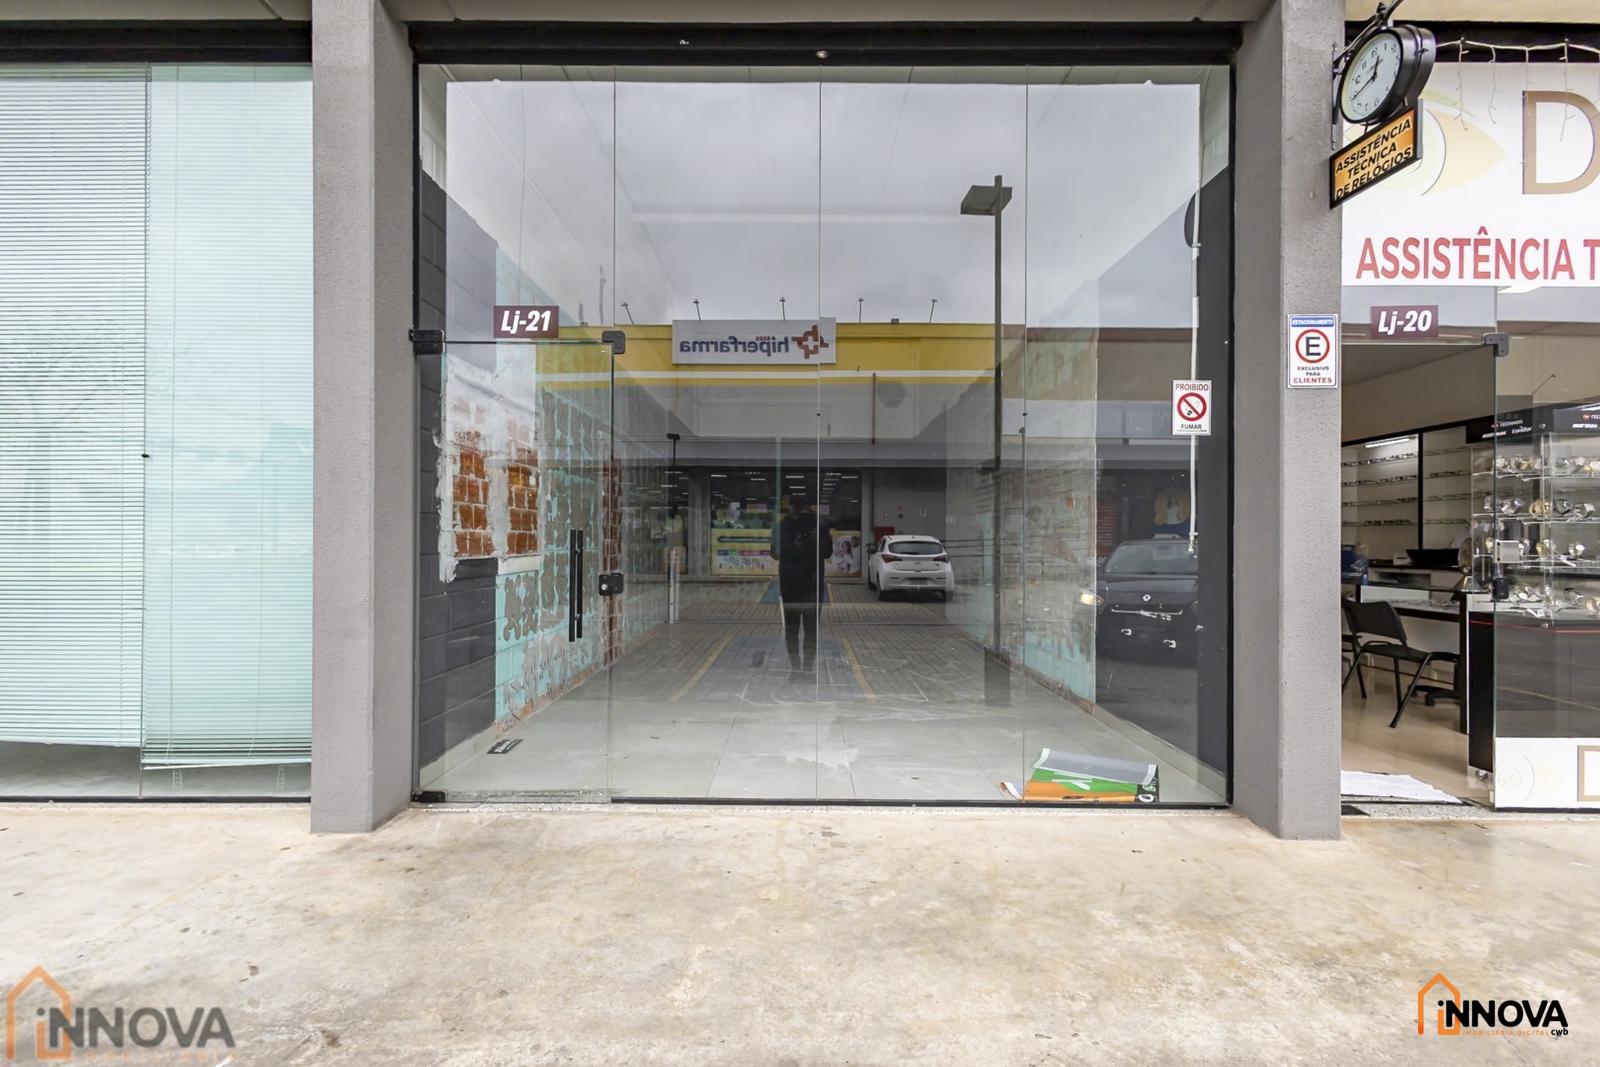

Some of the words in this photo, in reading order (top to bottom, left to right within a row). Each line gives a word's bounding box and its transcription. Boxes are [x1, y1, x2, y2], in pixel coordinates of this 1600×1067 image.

[1336, 118, 1412, 174] ASSISTÊNCIA
[1347, 141, 1397, 179] TÉCNICA
[1335, 183, 1350, 199] DE
[1351, 146, 1412, 193] RELÓGIOS
[1355, 226, 1576, 281] ASSISTÊNCIA
[501, 309, 551, 335] Lj-21
[1378, 309, 1433, 336] Lj-20
[1306, 337, 1321, 356] E
